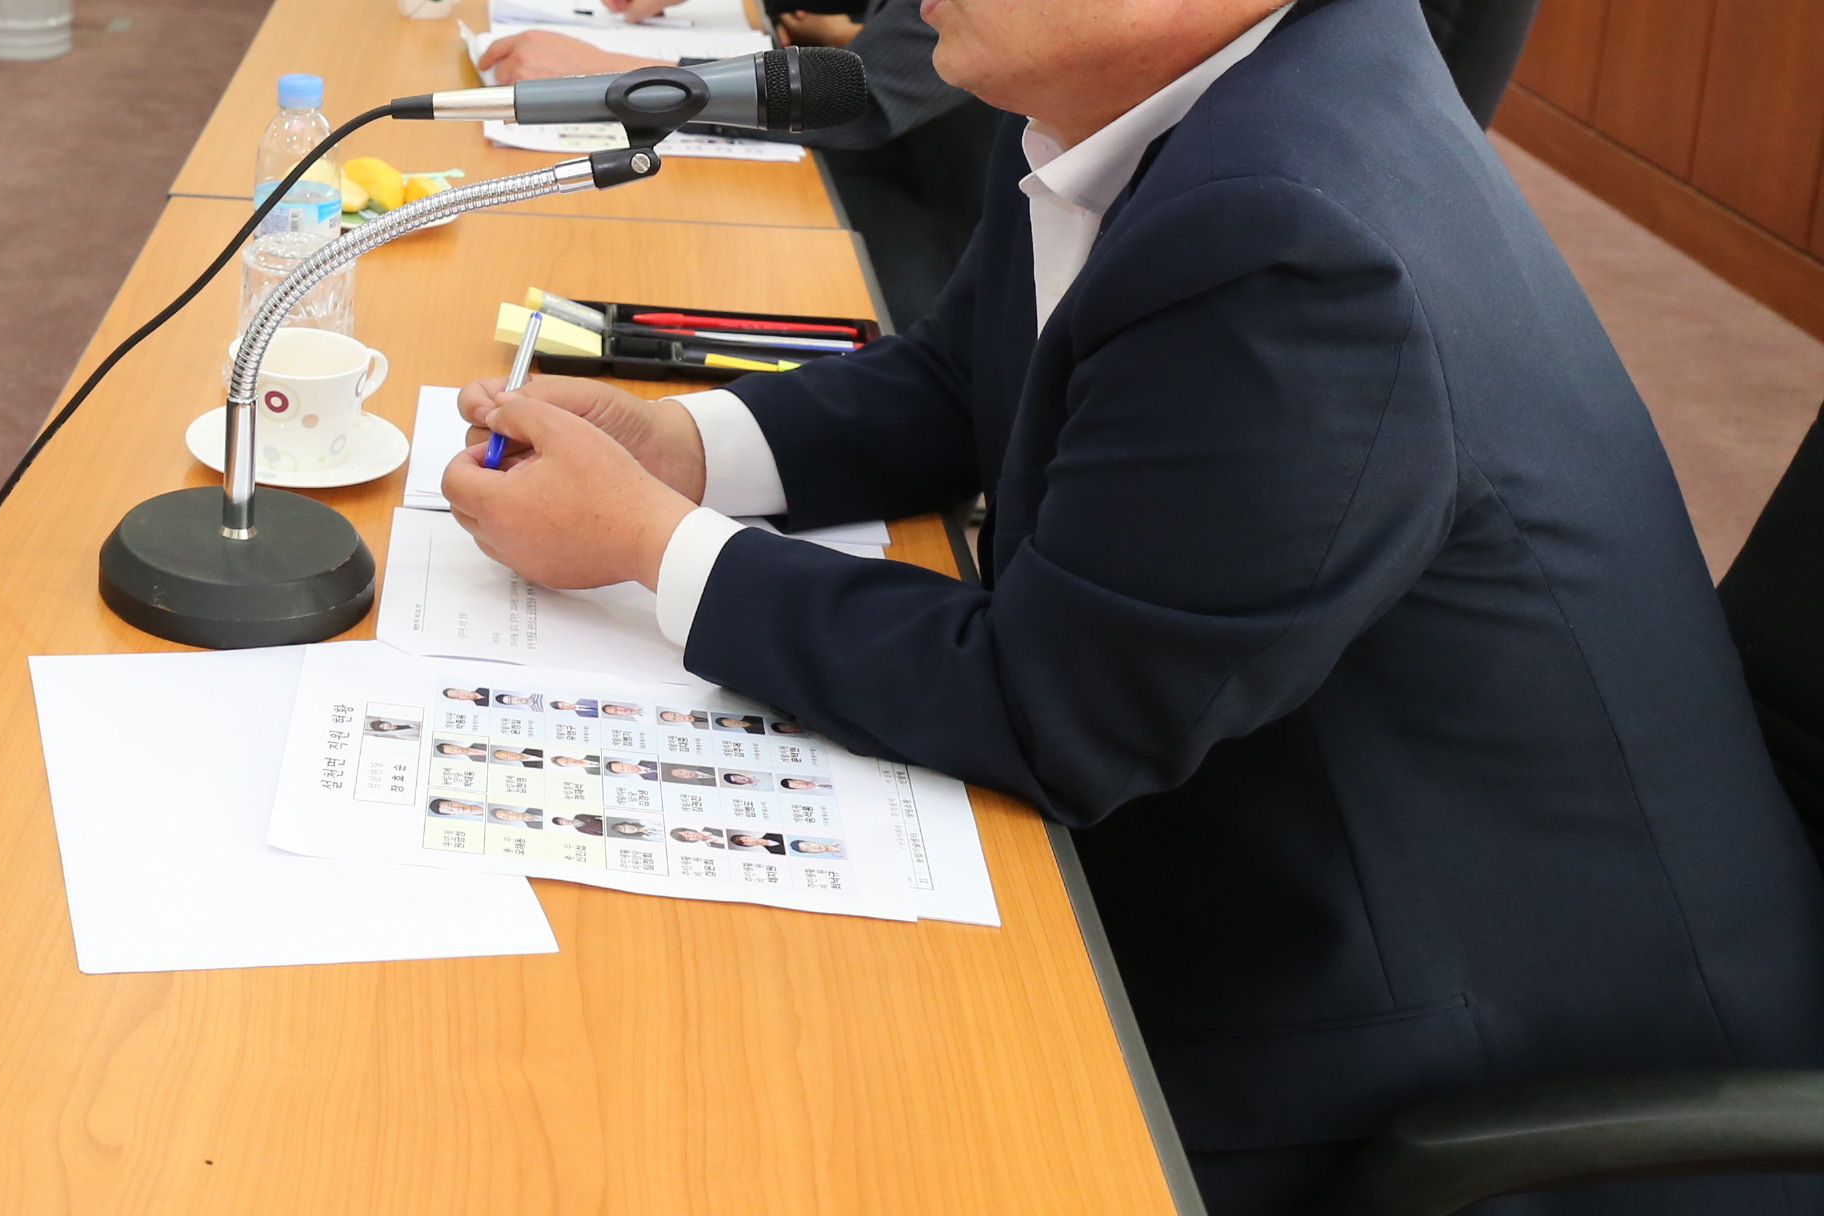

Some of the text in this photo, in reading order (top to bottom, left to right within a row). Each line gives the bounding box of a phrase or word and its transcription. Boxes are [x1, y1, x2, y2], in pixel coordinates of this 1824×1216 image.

[320, 704, 354, 790] 설천면 직원 현황
